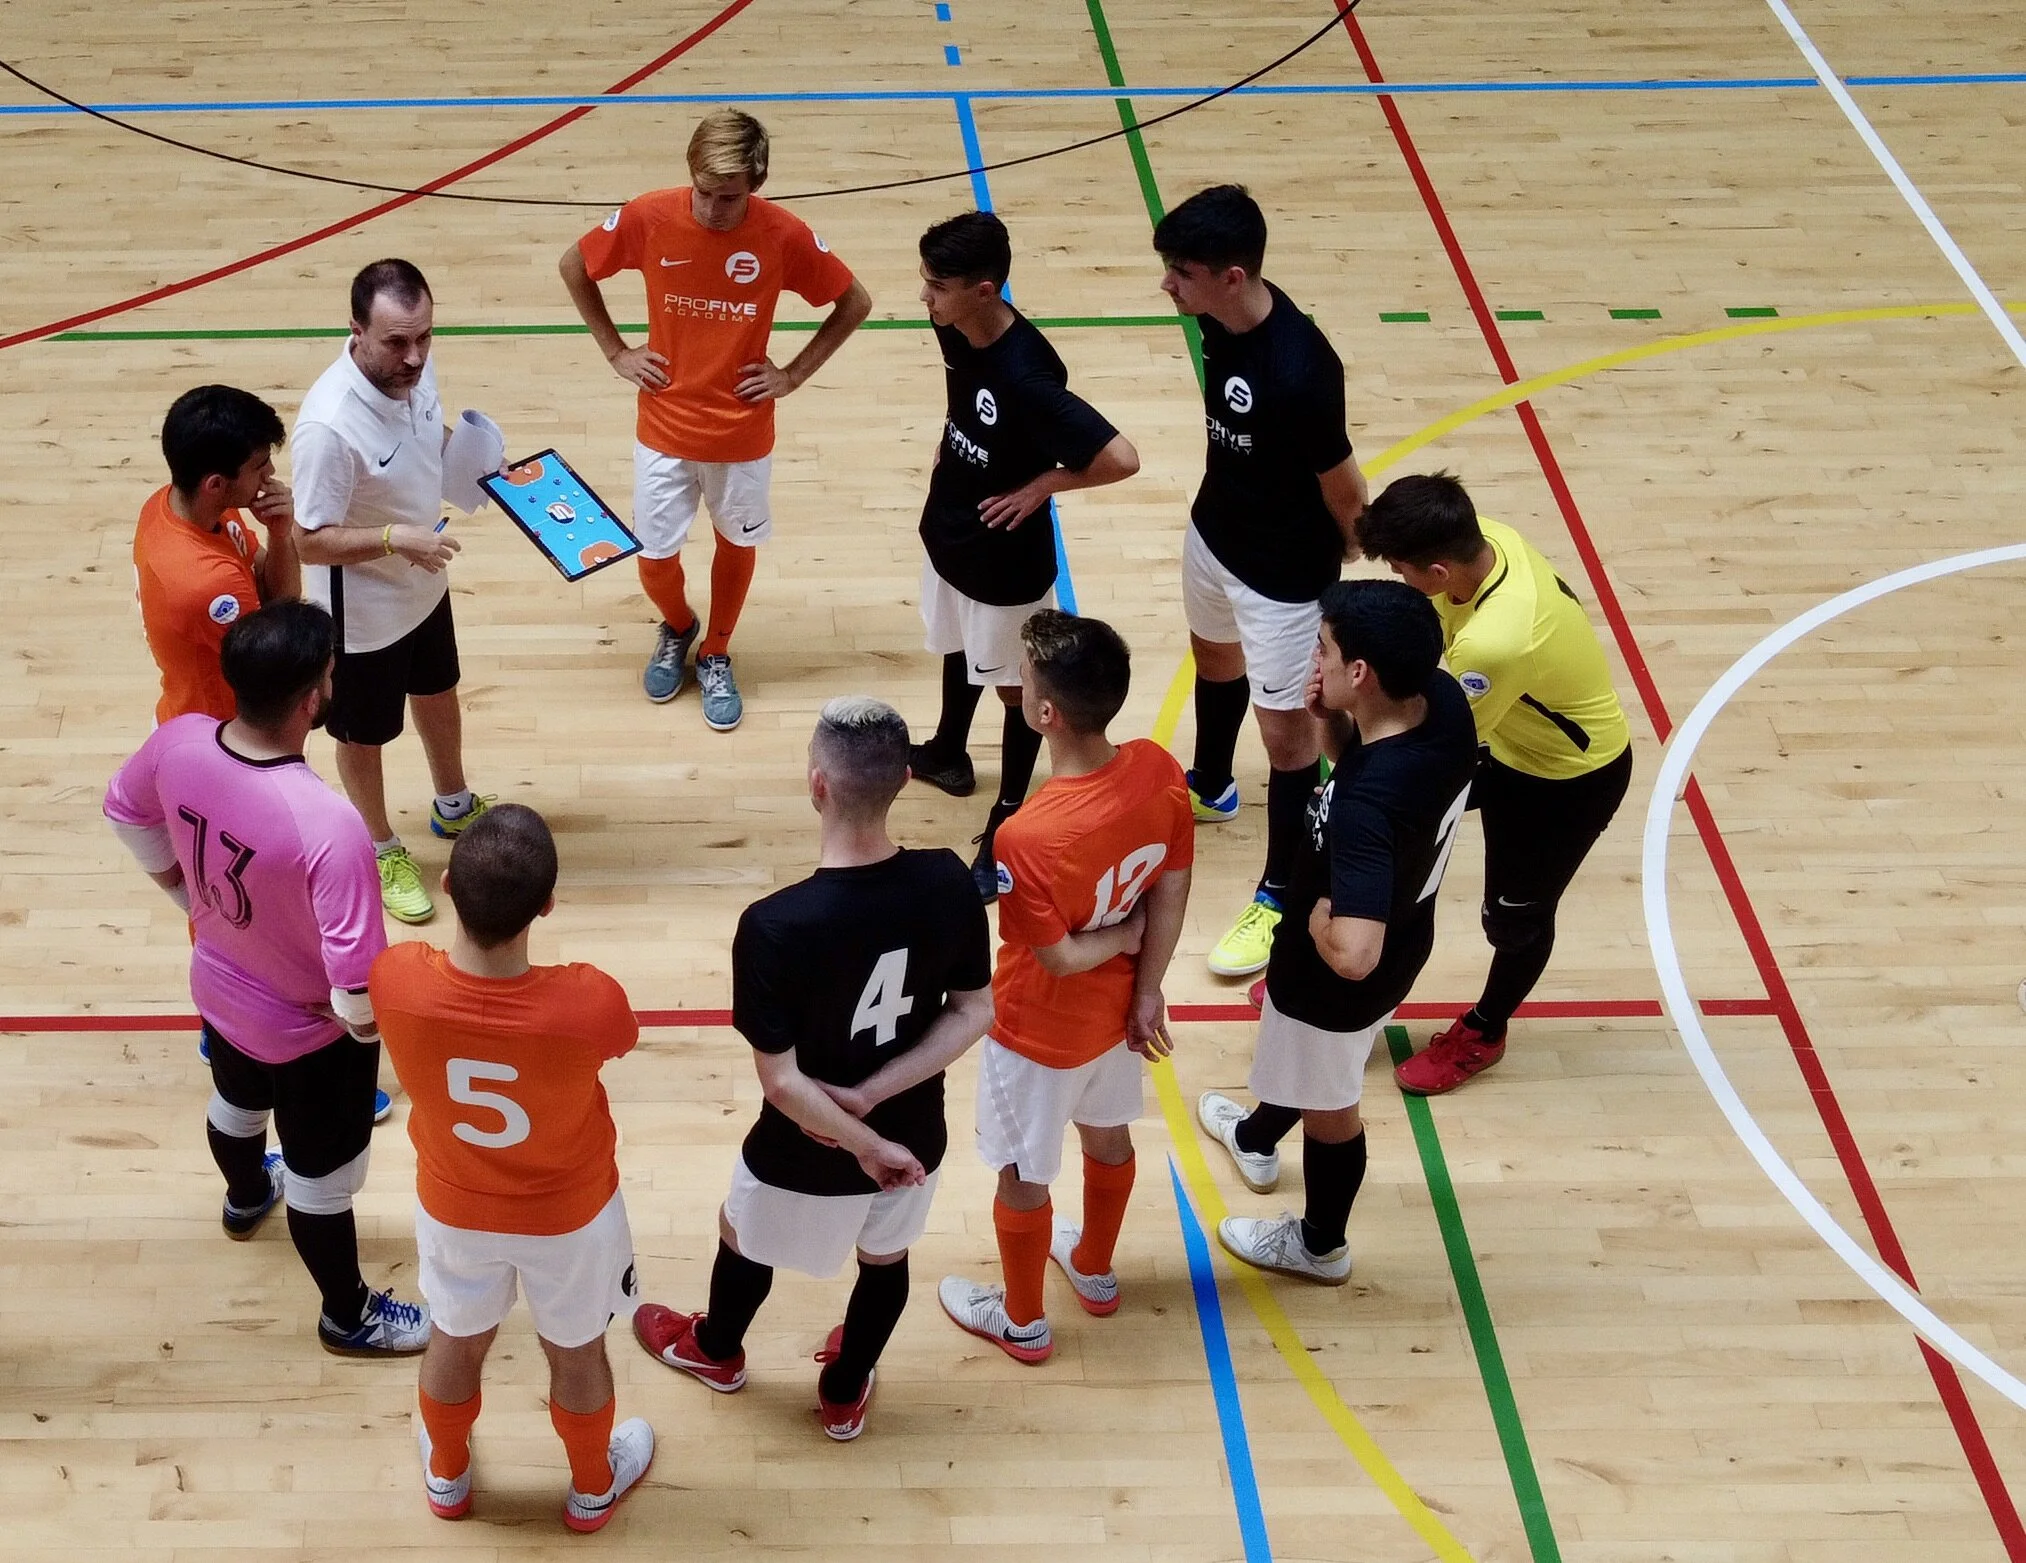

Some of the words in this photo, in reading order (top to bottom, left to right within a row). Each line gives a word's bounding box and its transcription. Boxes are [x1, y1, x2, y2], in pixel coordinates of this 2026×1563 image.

[664, 293, 757, 316] PROFIVE
[664, 306, 756, 323] ACADEMY
[947, 419, 989, 463] OFIVE
[178, 804, 257, 930] 13
[1081, 843, 1167, 931] 12
[851, 948, 914, 1046] 4
[446, 1058, 531, 1148] 5
